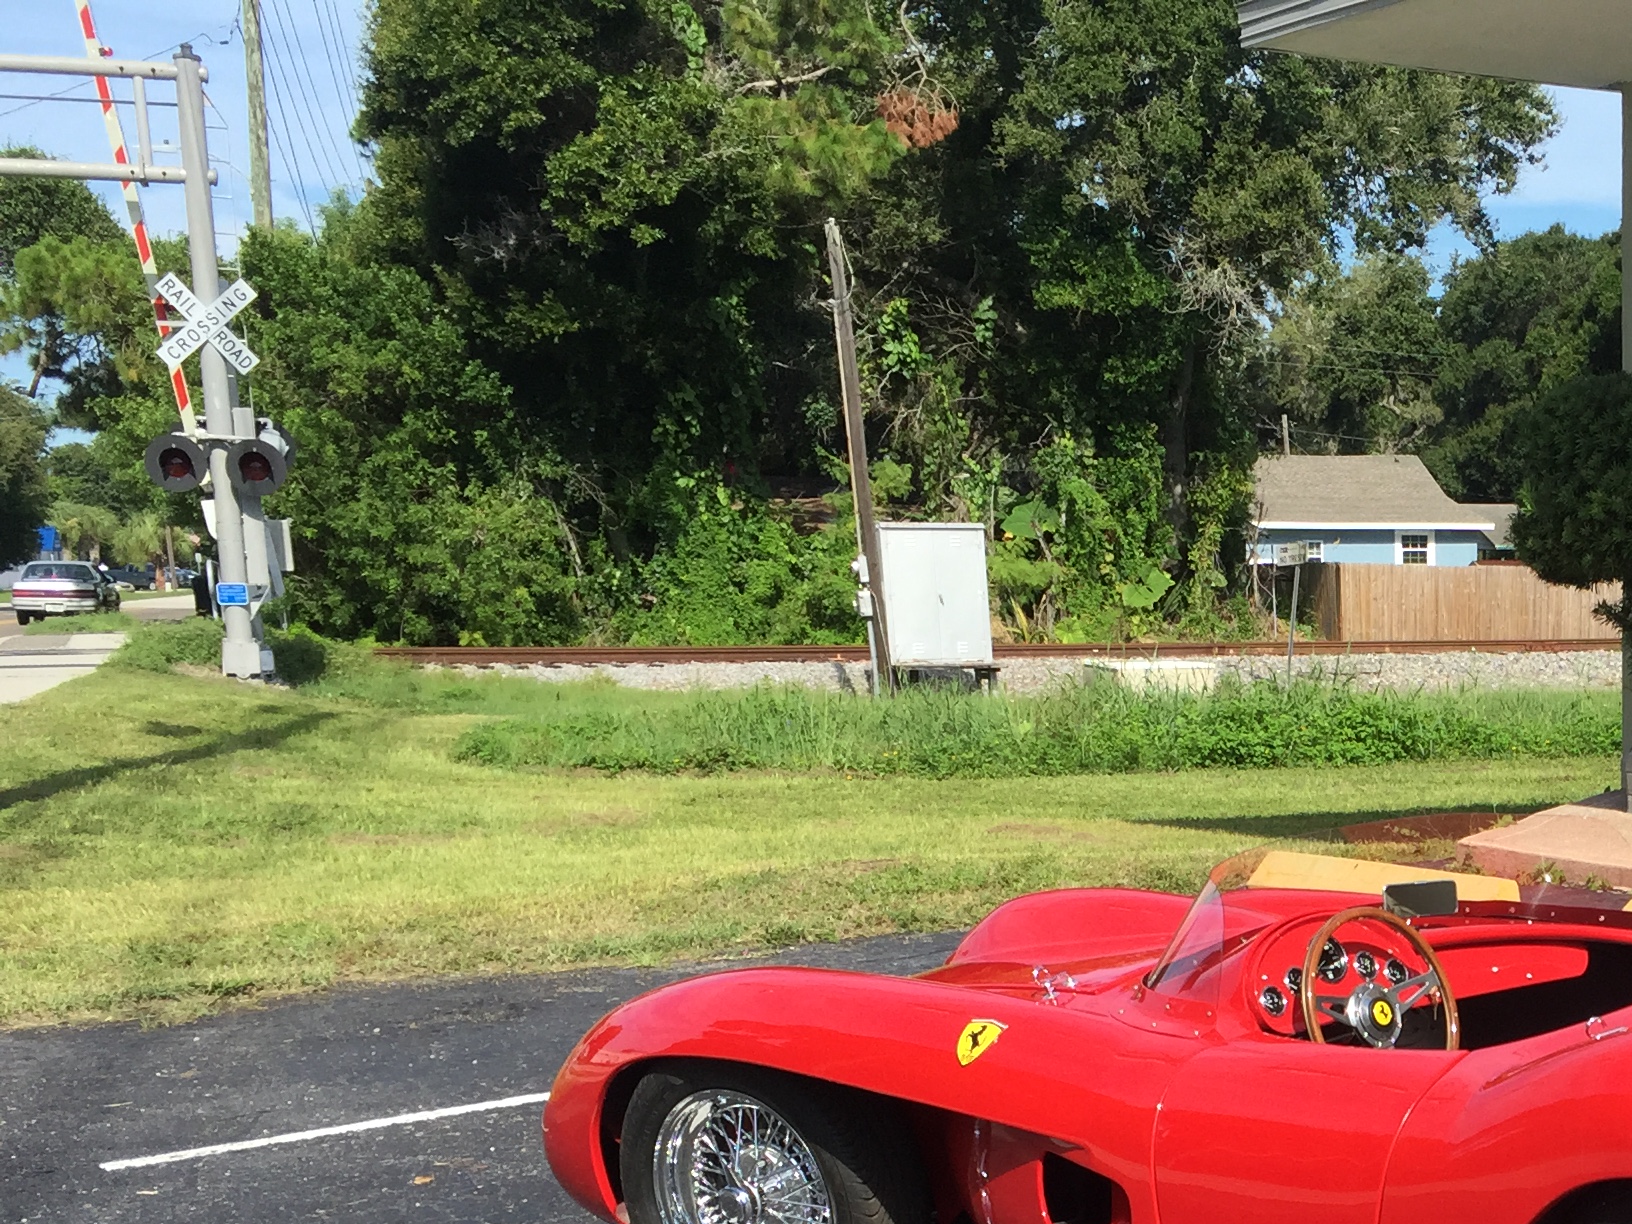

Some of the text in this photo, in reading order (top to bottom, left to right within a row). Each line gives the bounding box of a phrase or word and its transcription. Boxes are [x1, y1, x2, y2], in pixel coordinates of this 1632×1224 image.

[161, 278, 253, 369] RAIL ROAD
[167, 288, 247, 359] CROSSING
